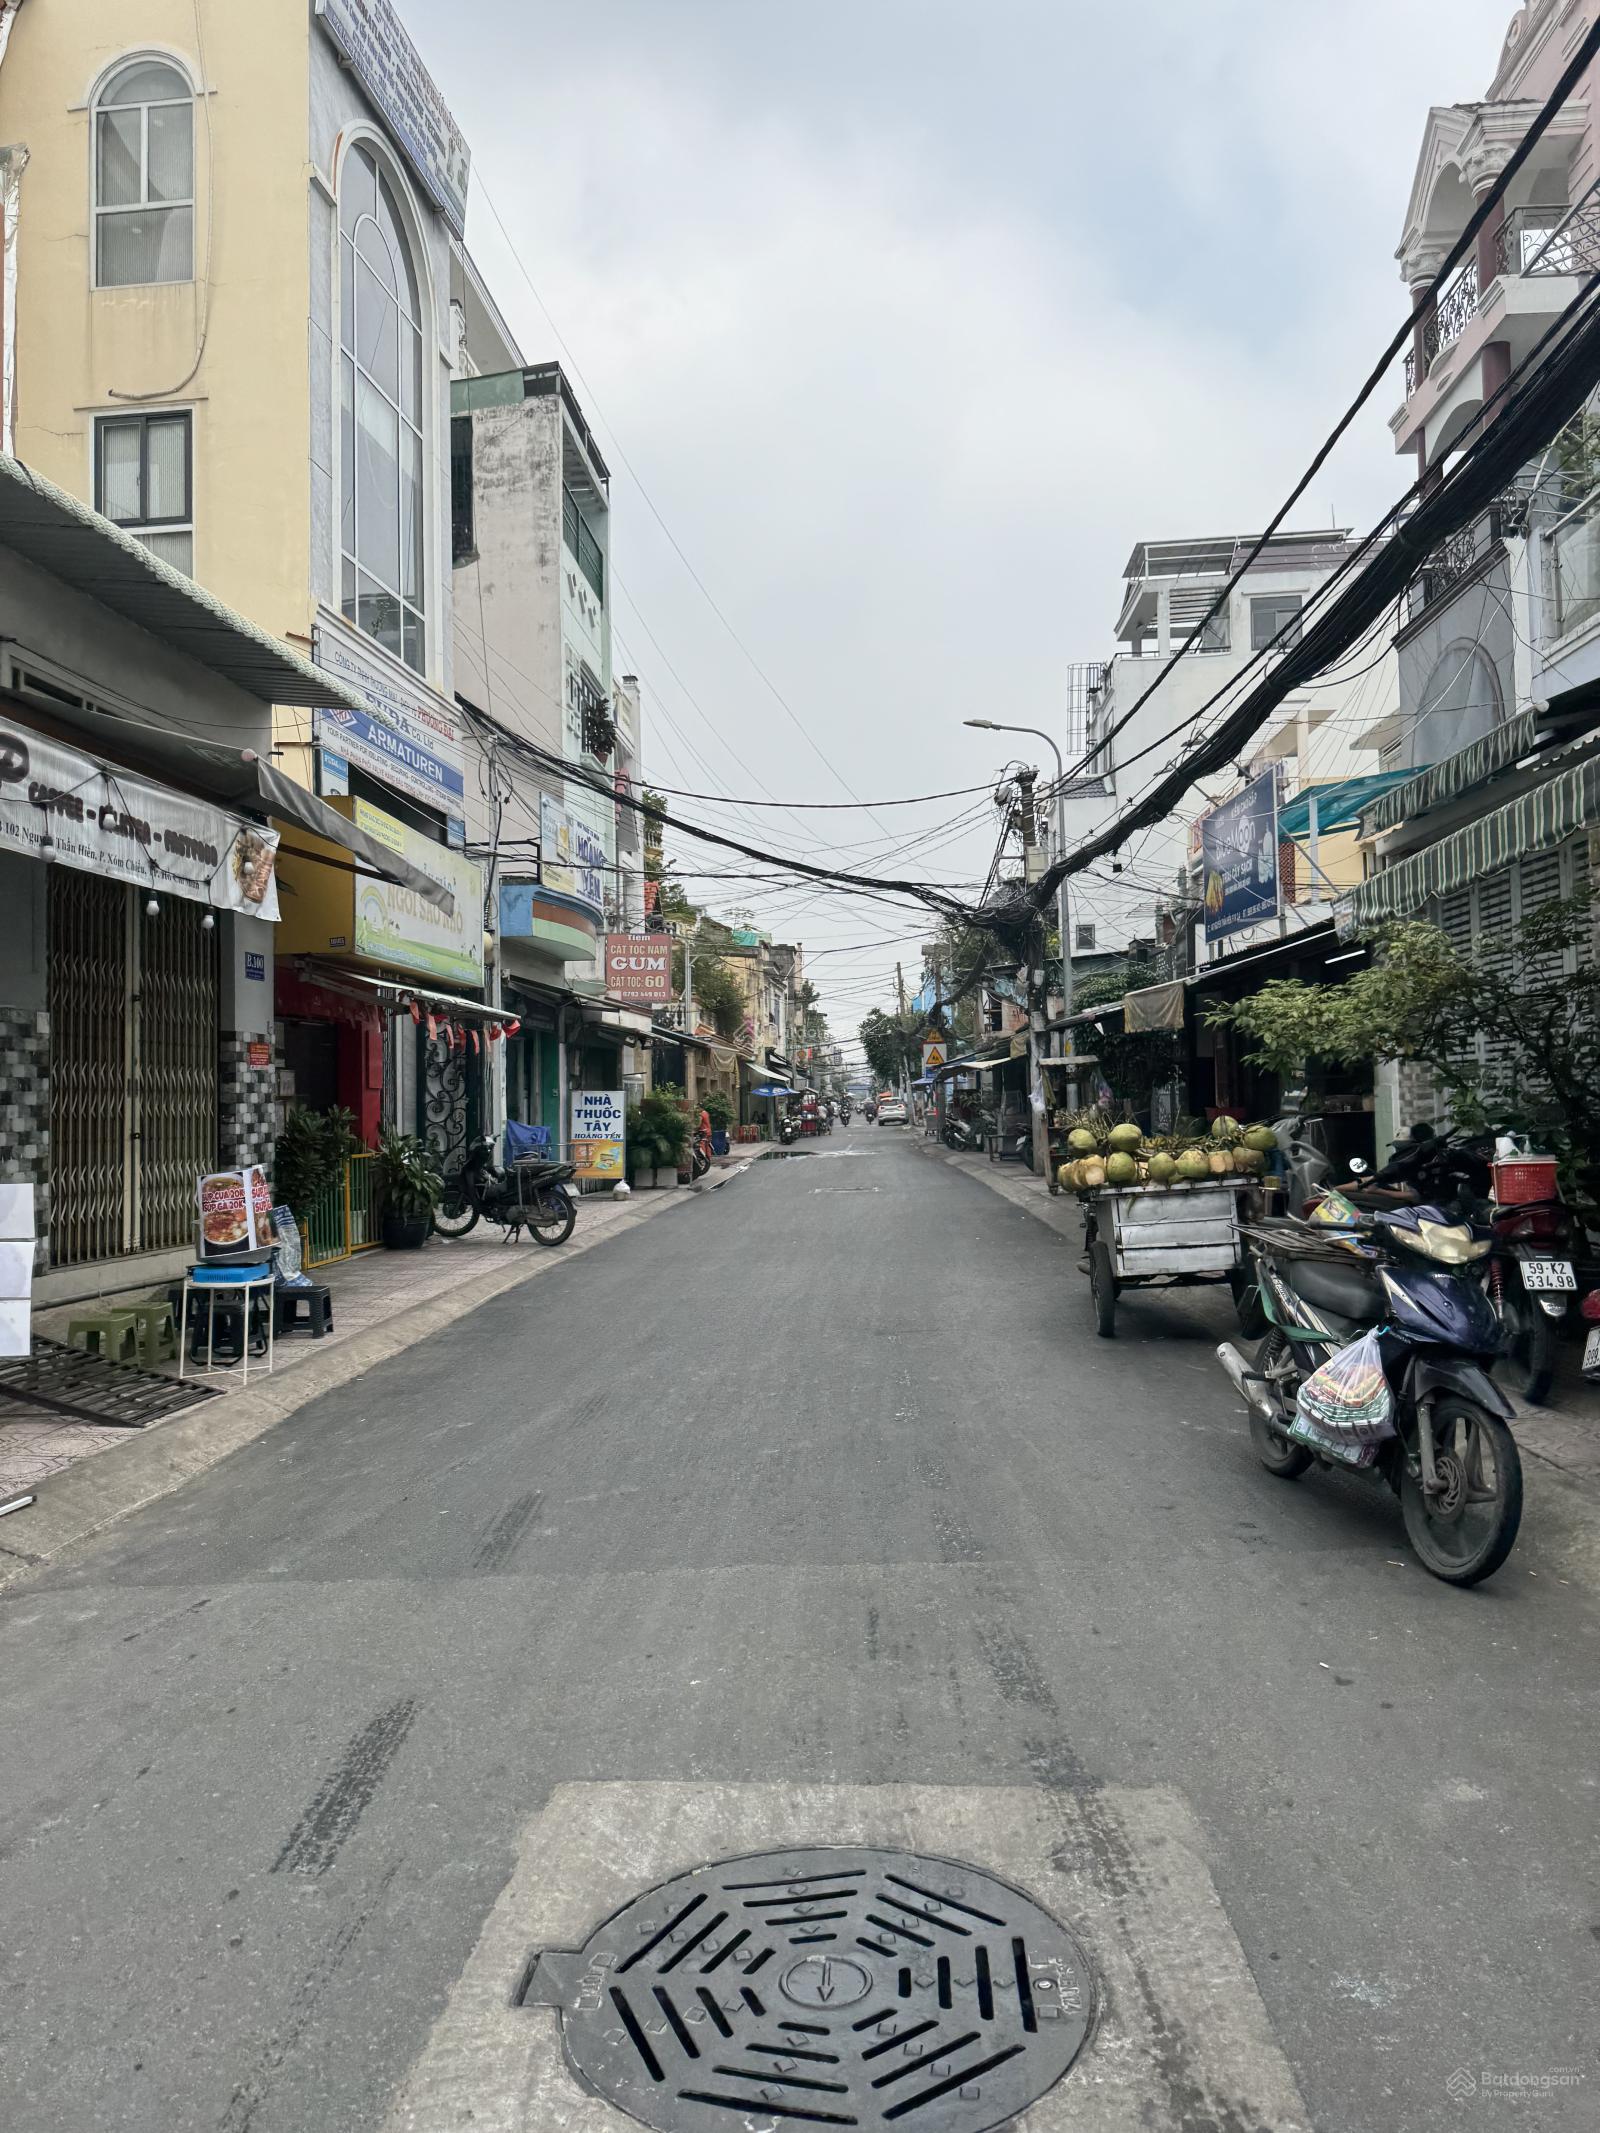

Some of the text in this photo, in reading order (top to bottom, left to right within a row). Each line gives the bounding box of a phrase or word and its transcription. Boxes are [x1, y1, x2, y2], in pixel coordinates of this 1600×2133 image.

[368, 724, 443, 783] ARMATUREN
[5, 822, 19, 837] 102
[22, 826, 48, 846] Nguy
[647, 945, 668, 955] NAM
[611, 956, 667, 971] GUM
[584, 1094, 611, 1106] NHÀ
[574, 1106, 621, 1118] THUỐC
[583, 1120, 611, 1131] TÂY
[1528, 1262, 1566, 1275] 59-K2
[1527, 1275, 1575, 1288] 534.98
